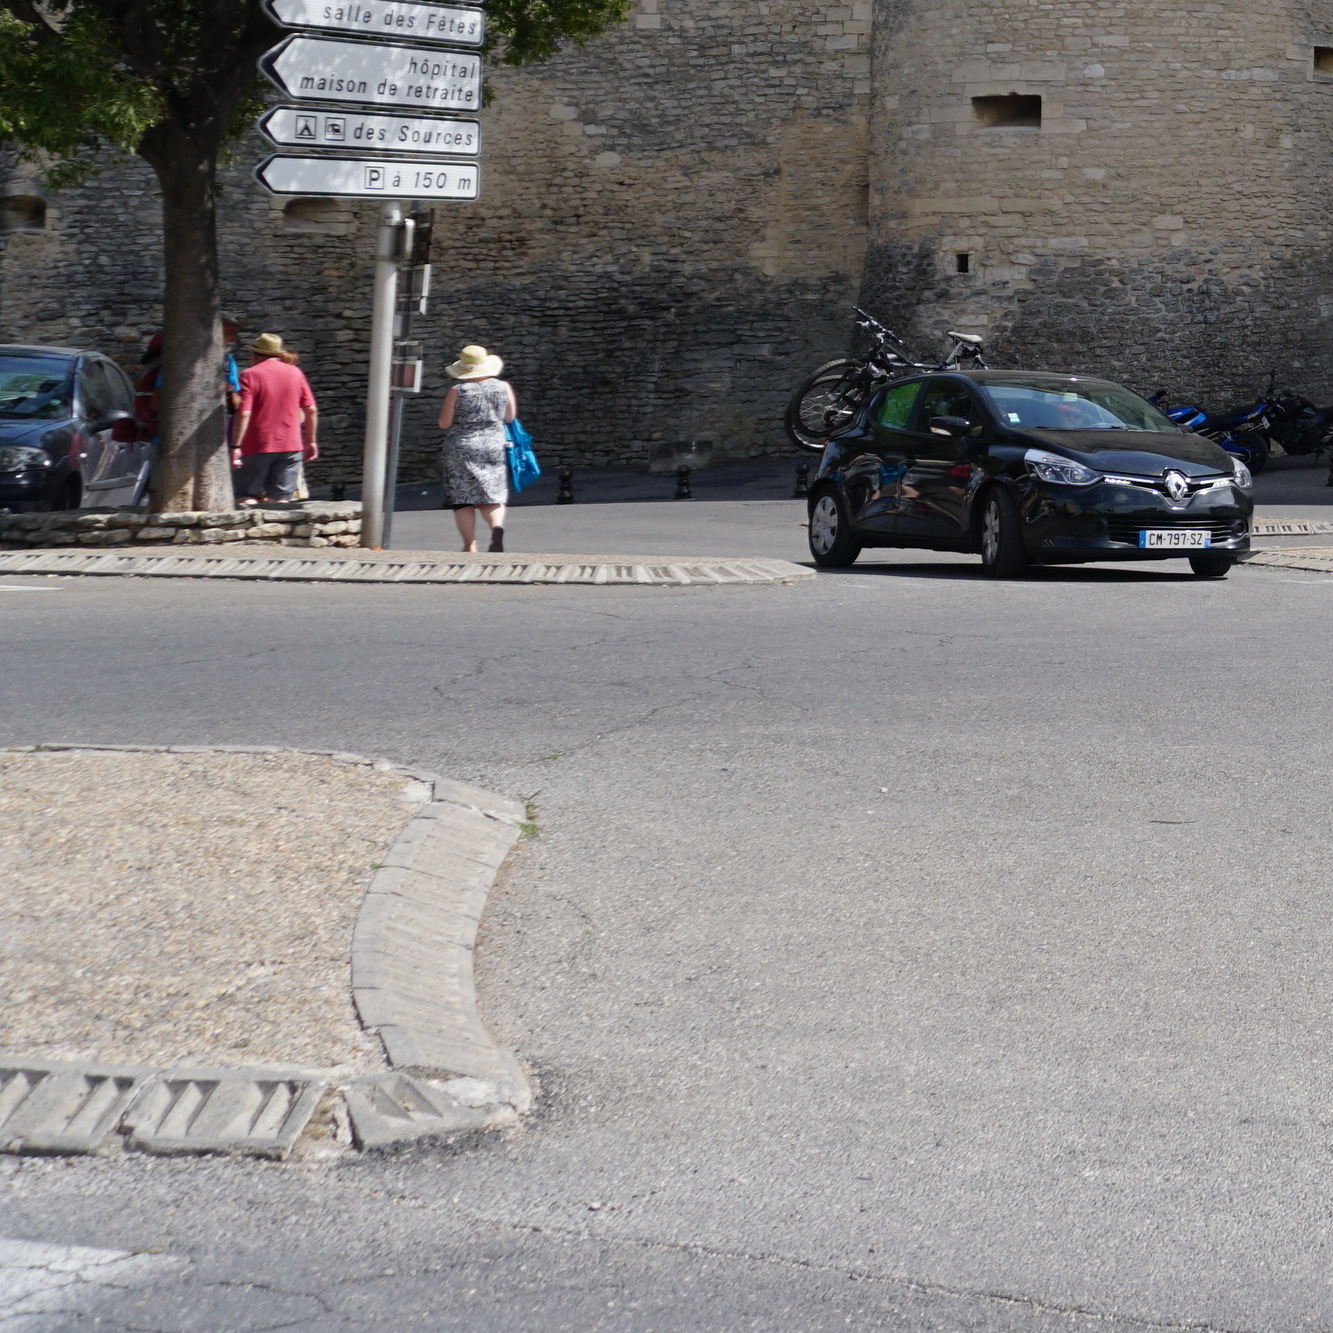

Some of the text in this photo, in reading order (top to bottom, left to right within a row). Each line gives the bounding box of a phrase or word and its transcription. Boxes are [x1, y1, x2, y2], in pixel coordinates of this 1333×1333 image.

[323, 4, 476, 35] salle des Fêtes
[408, 56, 475, 80] hôpital
[300, 74, 474, 103] maison de retraite
[354, 122, 473, 146] des Sources
[392, 169, 401, 188] à
[414, 171, 447, 189] 150
[458, 177, 471, 190] m
